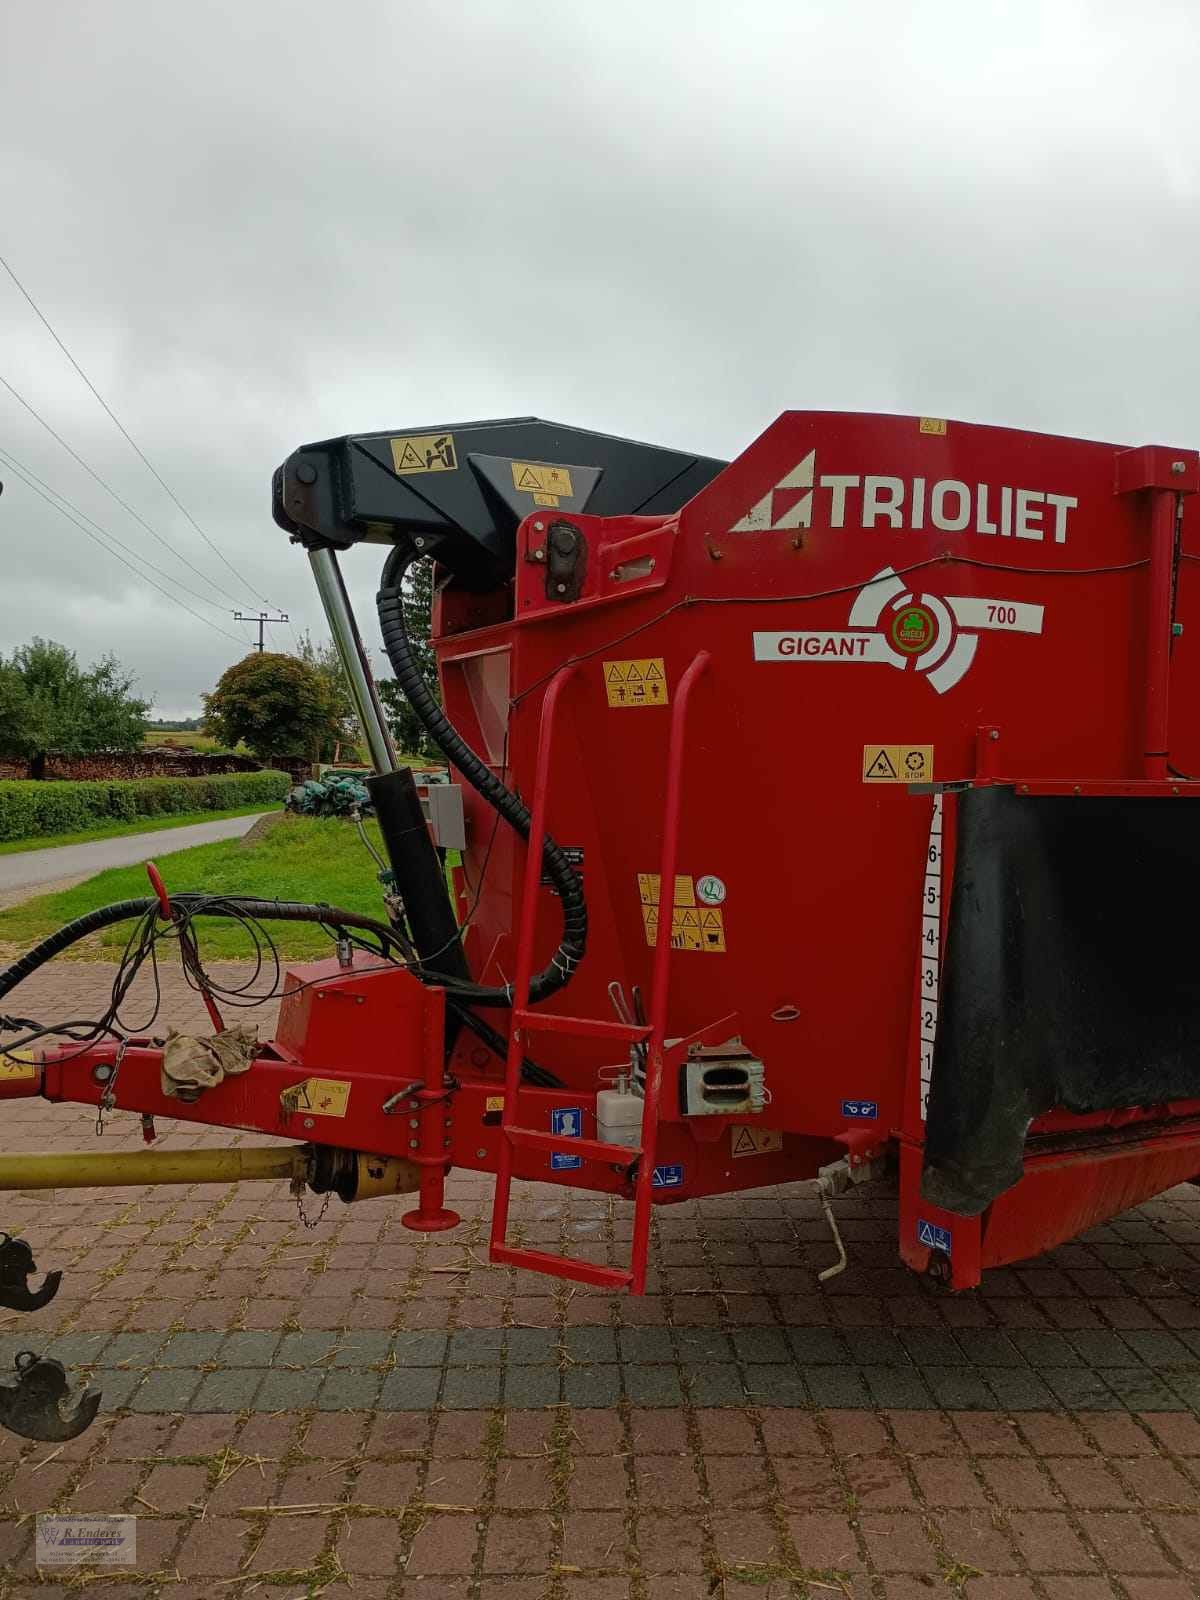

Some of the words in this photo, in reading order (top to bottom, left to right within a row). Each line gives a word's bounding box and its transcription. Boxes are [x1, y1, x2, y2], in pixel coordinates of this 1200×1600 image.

[820, 474, 1078, 544] TRIOLIET
[987, 605, 1016, 625] 700
[777, 636, 870, 657] GIGANT
[928, 845, 937, 863] 6
[927, 887, 936, 904] 5
[926, 928, 935, 945] 4
[925, 969, 934, 987] 3
[924, 1011, 933, 1029] 2
[925, 1053, 931, 1070] 1
